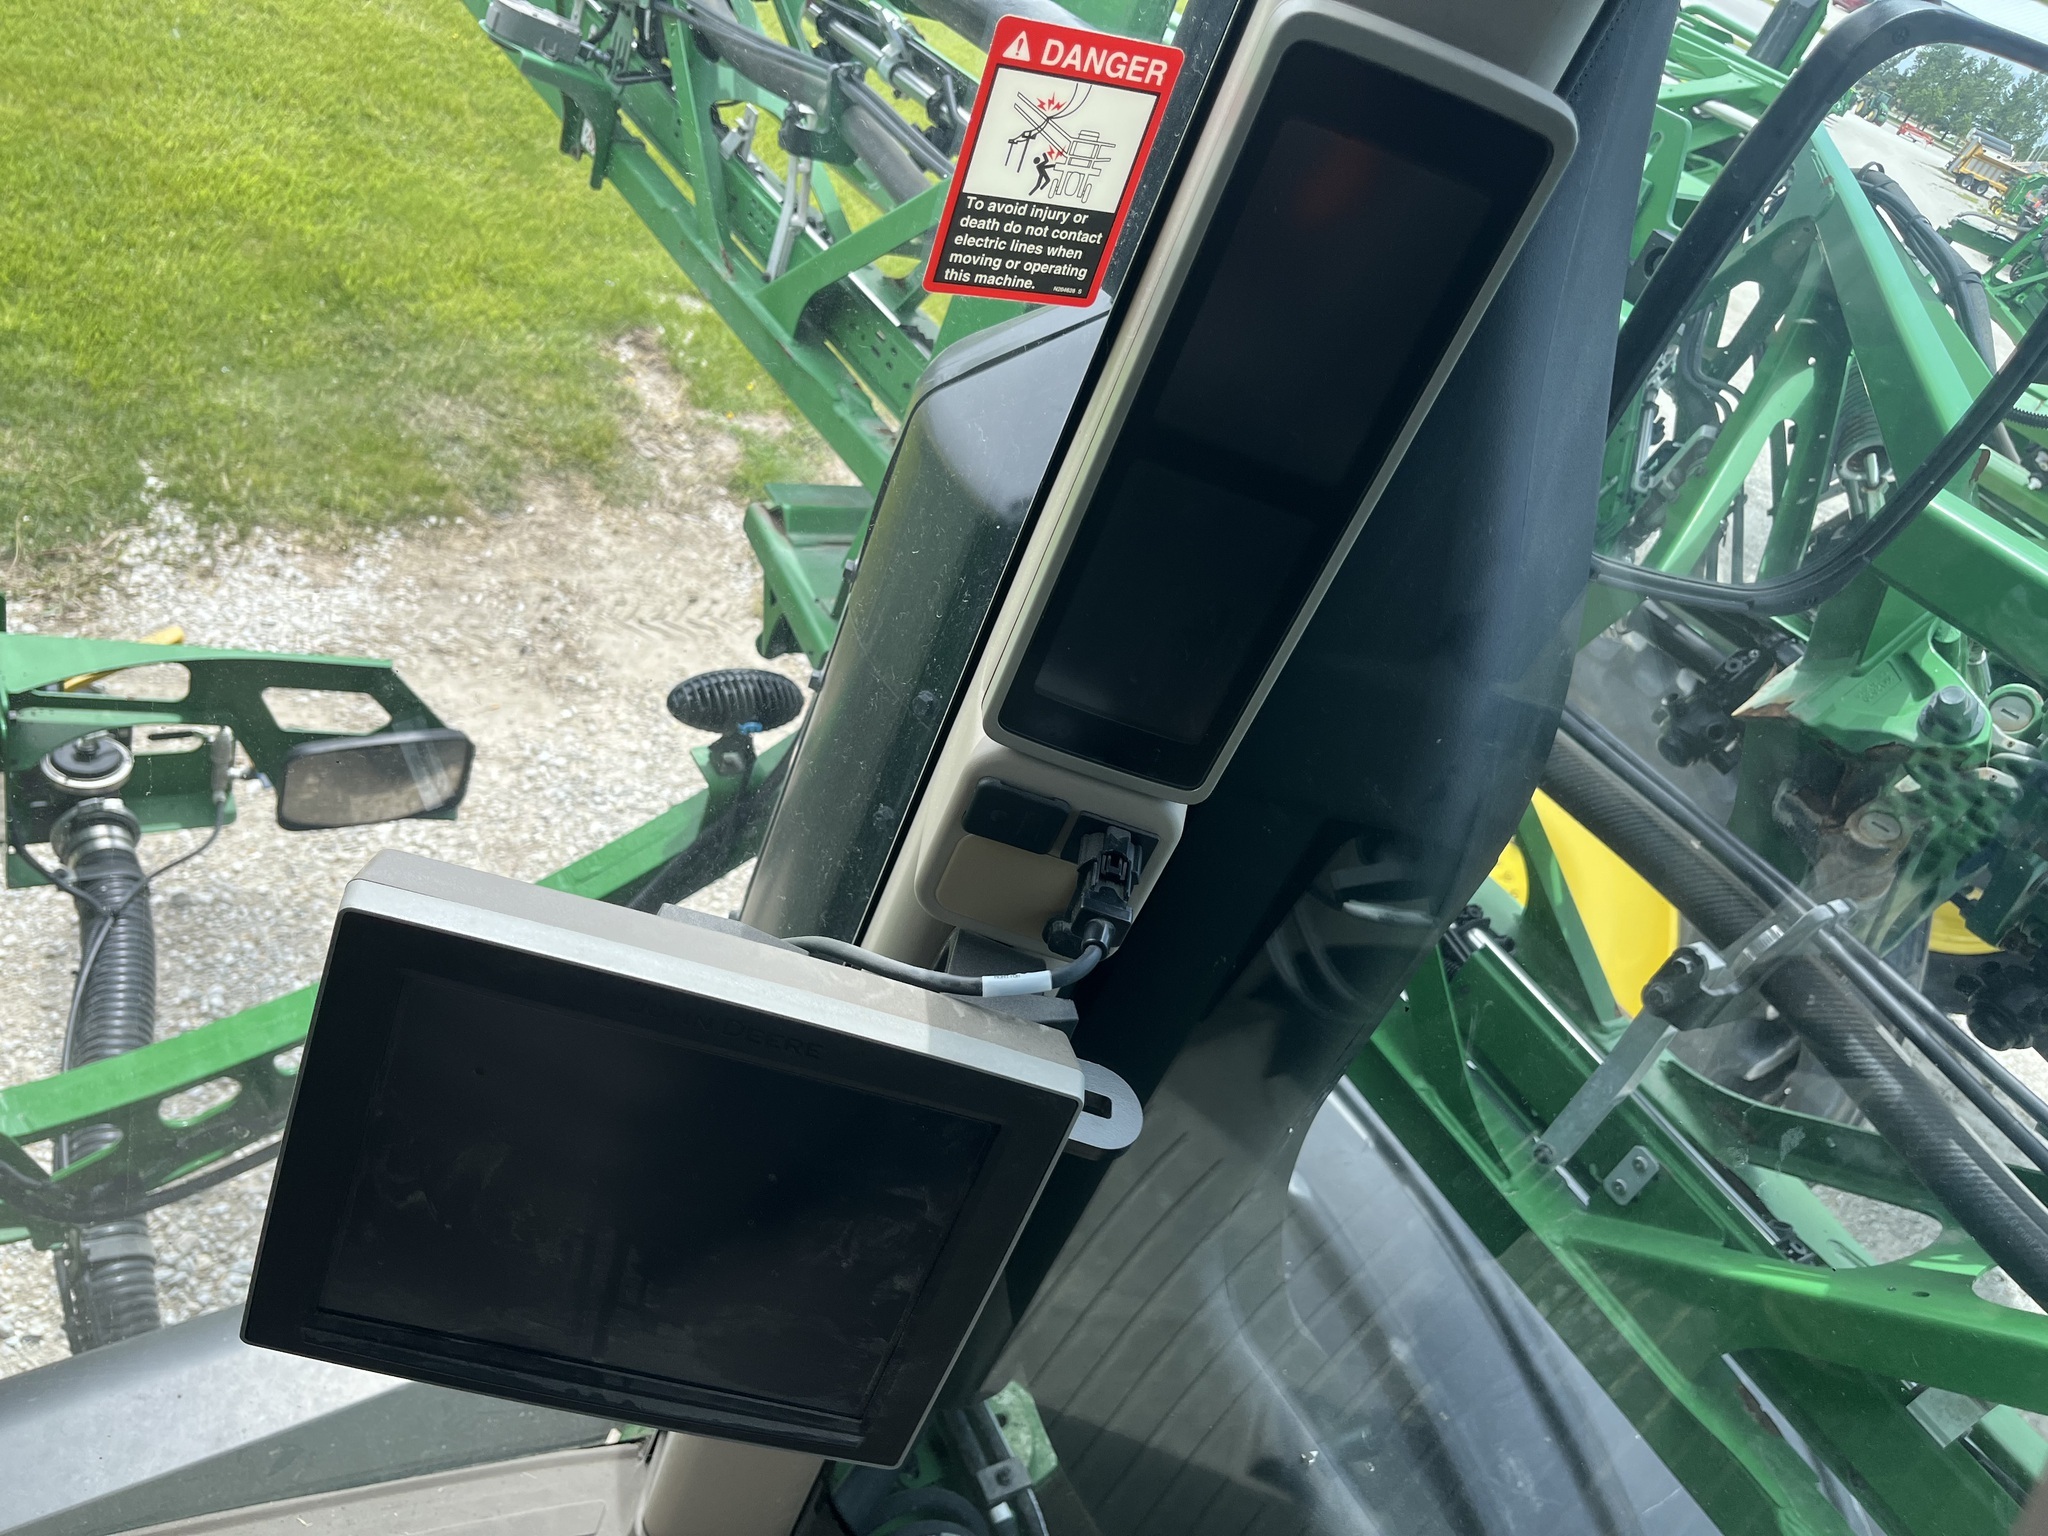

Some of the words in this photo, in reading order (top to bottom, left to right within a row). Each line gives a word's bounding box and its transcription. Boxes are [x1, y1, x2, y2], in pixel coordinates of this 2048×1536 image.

[1040, 38, 1168, 86] DANGER
[966, 195, 985, 211] To
[987, 201, 1029, 217] avoid
[1030, 204, 1071, 225] injury
[1072, 213, 1090, 224] or
[960, 214, 1000, 232] death
[1003, 220, 1022, 234] do
[1025, 224, 1050, 238] not
[1051, 228, 1103, 245] contact
[954, 233, 1007, 251] electric
[1009, 239, 1044, 255] lines
[1046, 244, 1083, 260] when
[944, 268, 971, 282] this
[973, 273, 1036, 290] machine.
[948, 252, 1003, 271] moving
[1004, 258, 1022, 270] or
[1023, 260, 1088, 281] operating
[721, 1019, 825, 1060] DEERE
